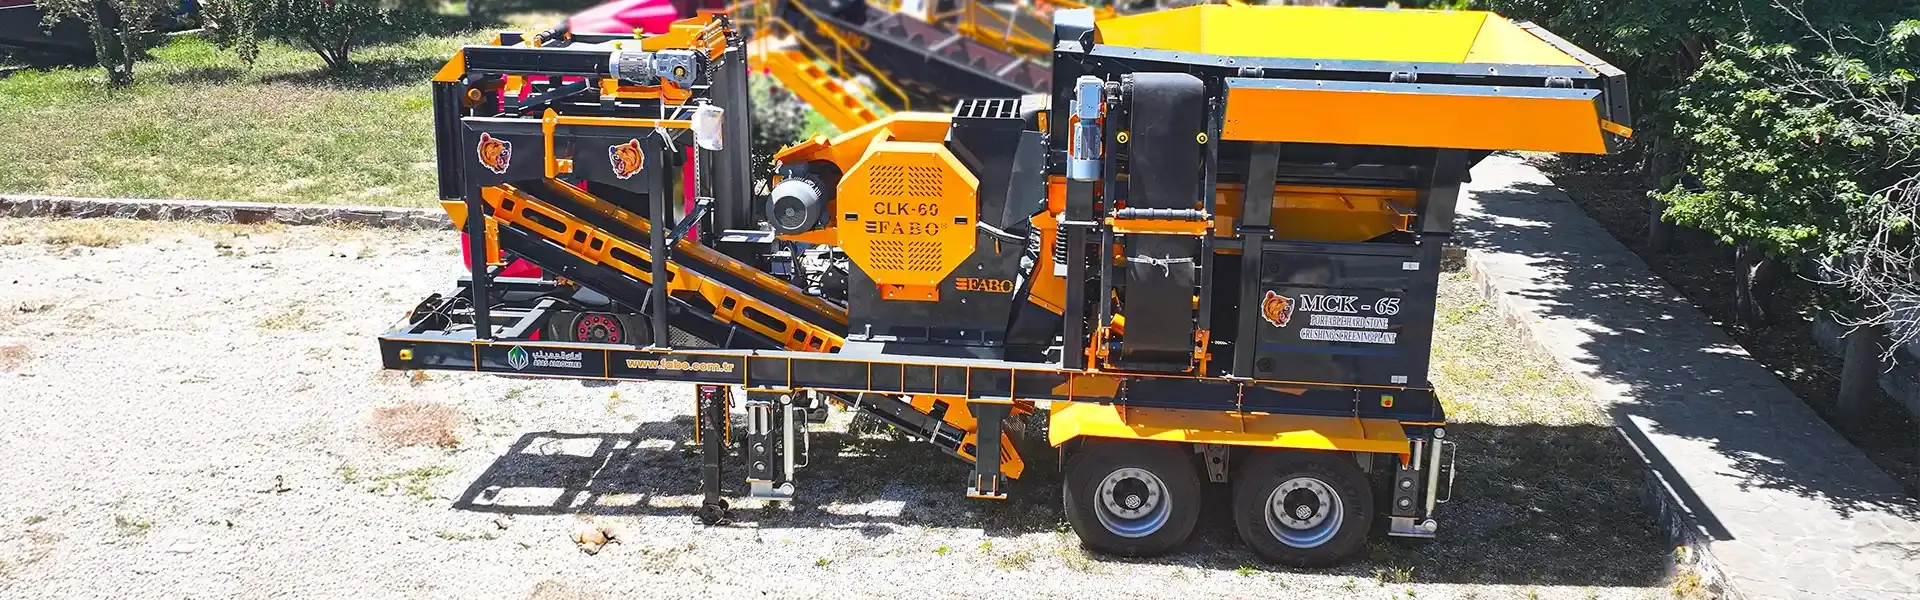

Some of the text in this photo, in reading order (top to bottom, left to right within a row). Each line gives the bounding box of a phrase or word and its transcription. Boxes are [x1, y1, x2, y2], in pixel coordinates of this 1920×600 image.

[874, 201, 939, 216] CLK-60
[1299, 294, 1358, 314] MCK
[1375, 297, 1400, 315] 65
[1310, 314, 1389, 329] PORTABLE HARD STONE
[1300, 328, 1397, 344] CRUSHING SCREENING PLANT
[626, 358, 734, 372] www.fabo.com.tr
